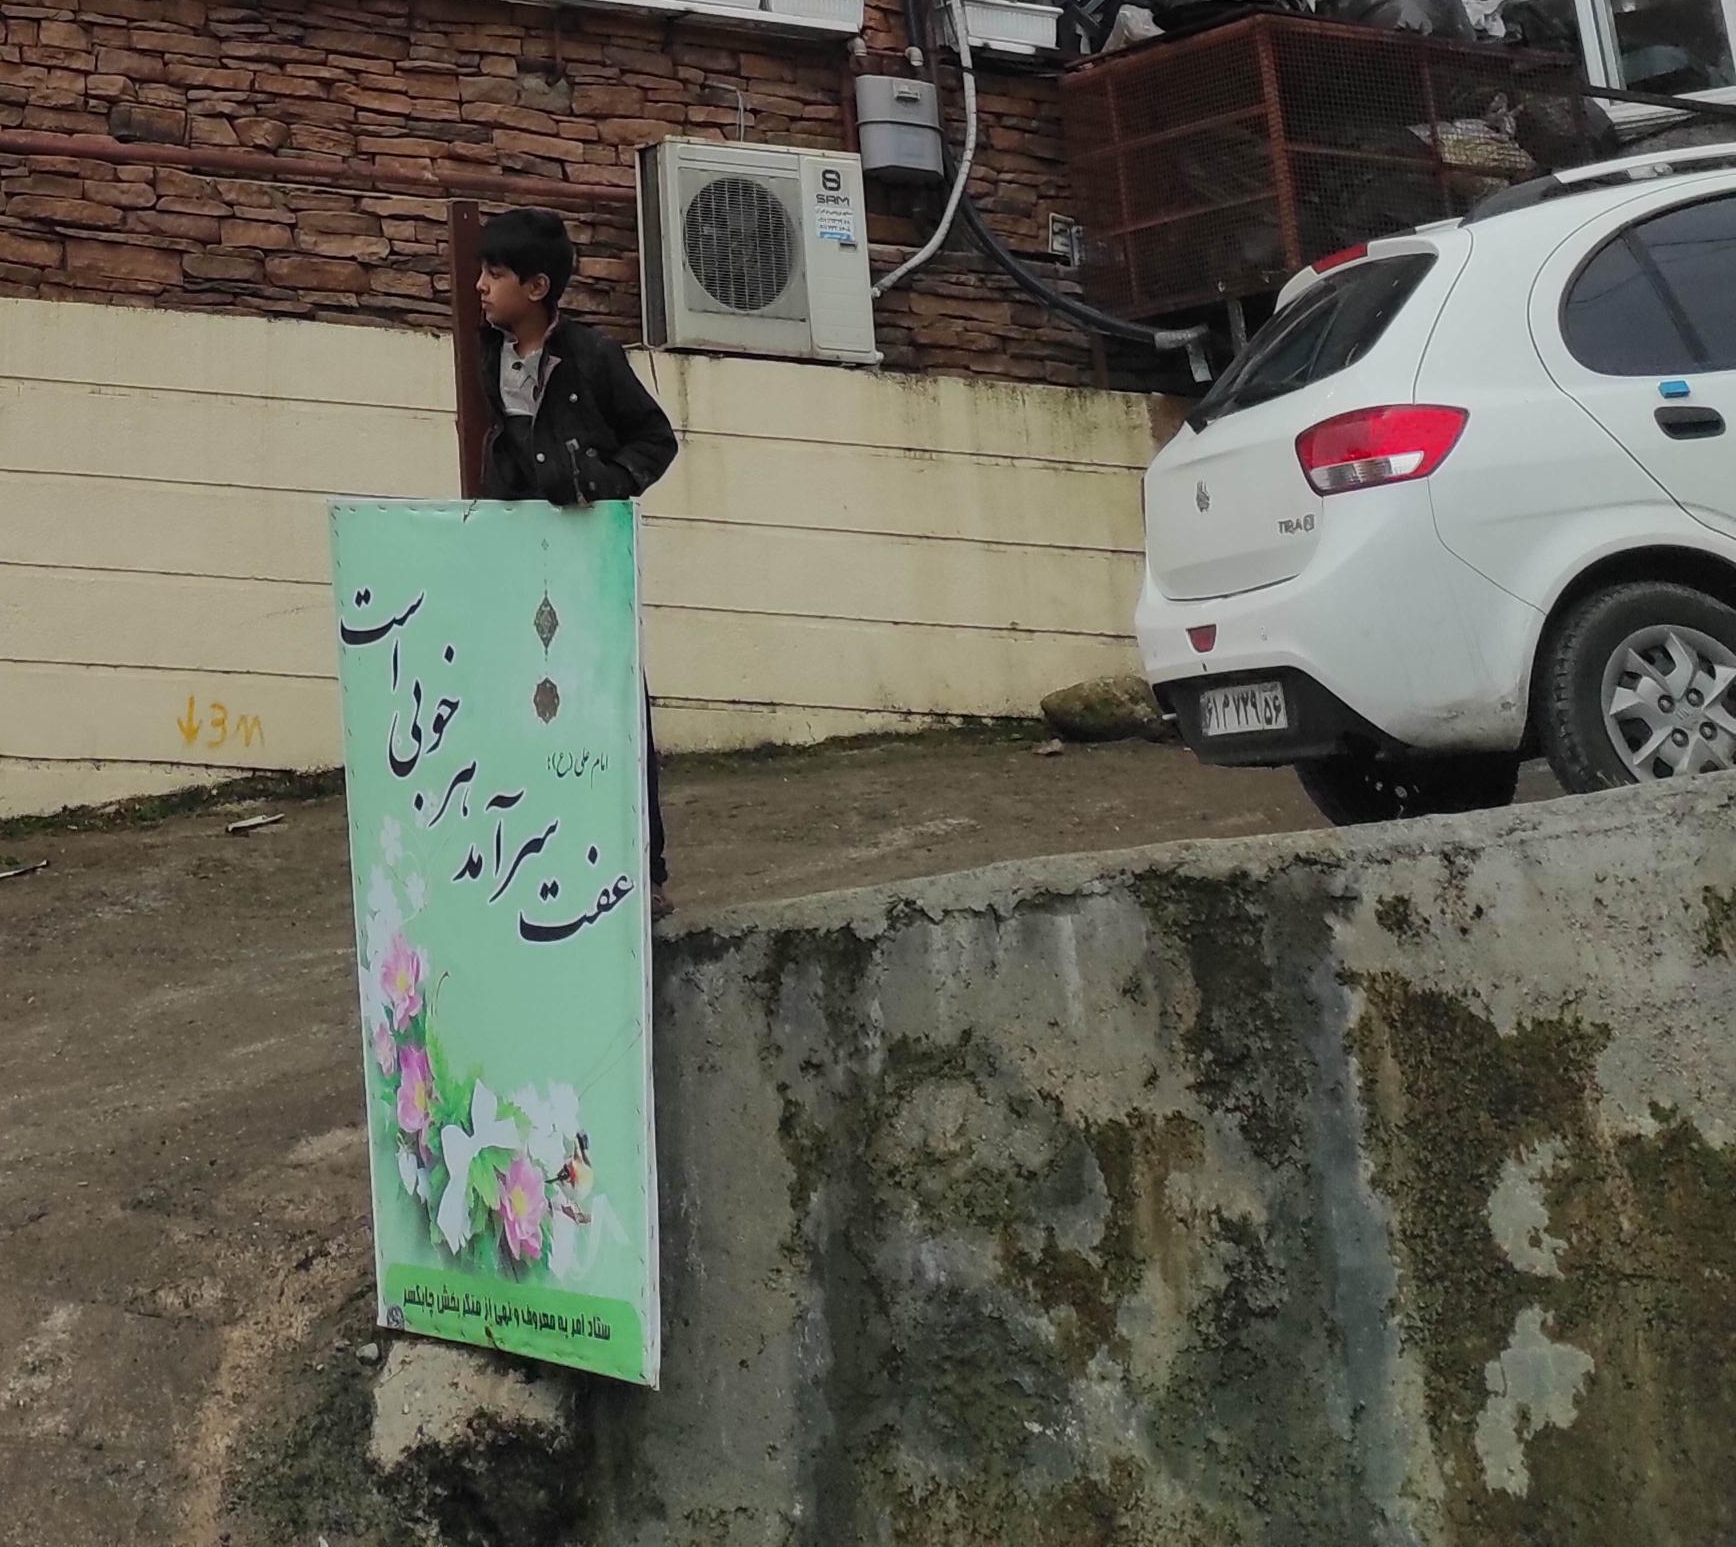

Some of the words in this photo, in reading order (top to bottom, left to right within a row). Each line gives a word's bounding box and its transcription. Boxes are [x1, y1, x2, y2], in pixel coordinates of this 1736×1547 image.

[339, 587, 425, 693] است
[573, 746, 590, 778] علی
[590, 751, 609, 790] امام
[518, 844, 636, 944] عفت
[484, 1295, 494, 1322] از
[494, 1301, 513, 1327] نهی
[522, 1305, 556, 1332] معروف
[557, 1314, 569, 1339] به
[571, 1312, 585, 1338] امر
[588, 1318, 612, 1341] ستاد
